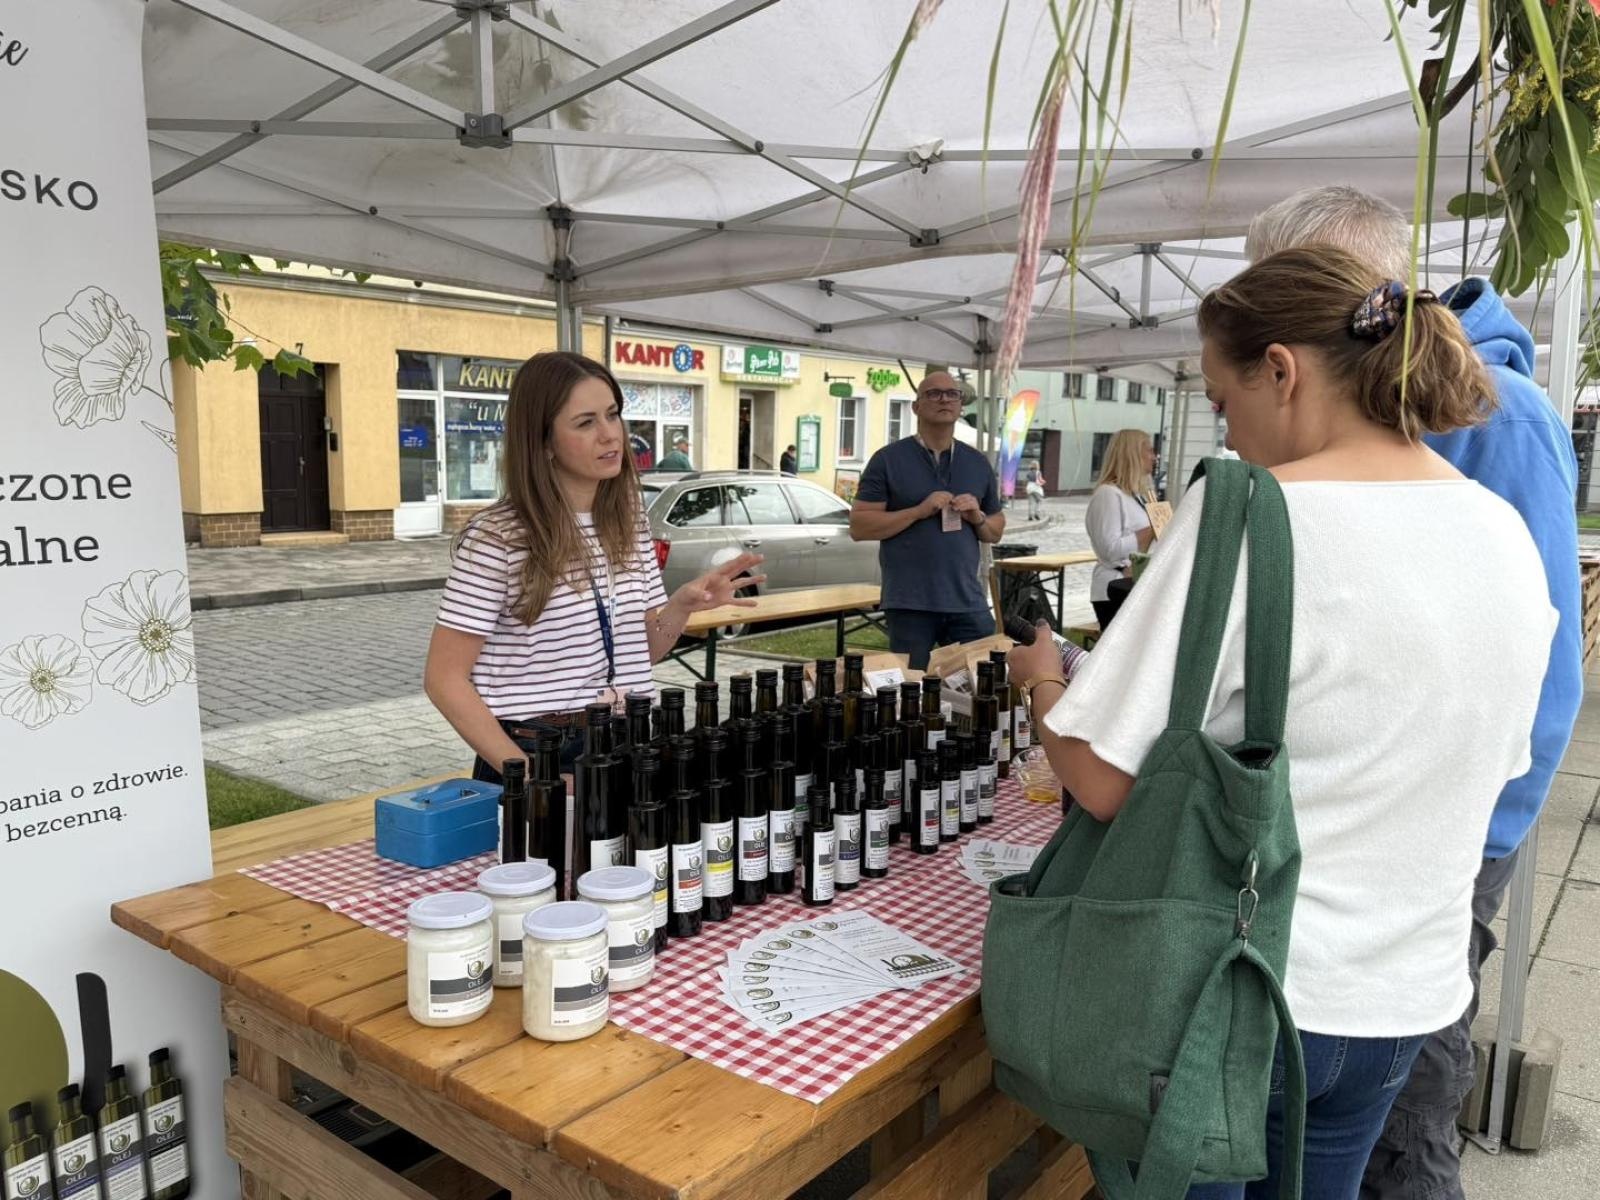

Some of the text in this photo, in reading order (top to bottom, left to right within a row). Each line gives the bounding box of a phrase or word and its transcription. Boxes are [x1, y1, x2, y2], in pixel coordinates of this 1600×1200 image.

[0, 169, 99, 211] SKO
[615, 341, 704, 373] KANTOR
[0, 473, 132, 501] zone
[71, 785, 85, 799] o
[93, 764, 188, 795] zdrowie.
[5, 805, 127, 842] bezcenną.
[111, 1150, 132, 1164] OLEJ
[66, 1171, 87, 1185] OLEJ
